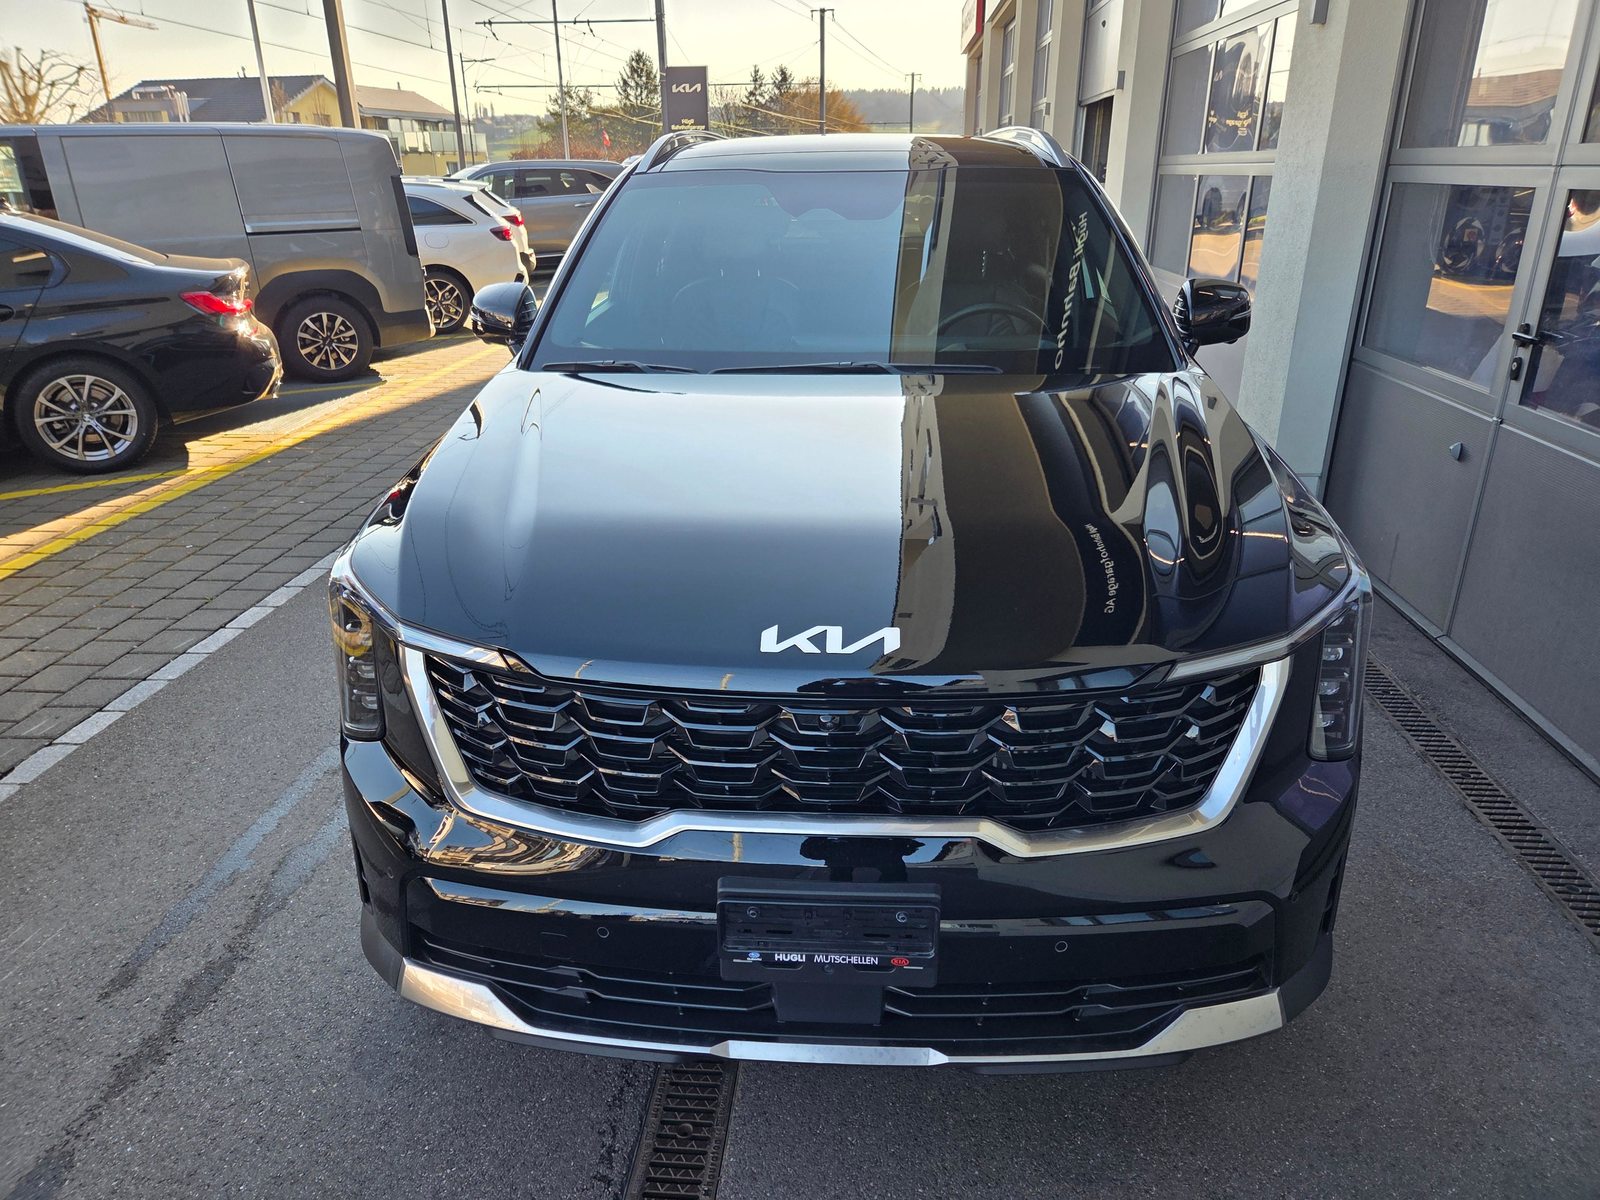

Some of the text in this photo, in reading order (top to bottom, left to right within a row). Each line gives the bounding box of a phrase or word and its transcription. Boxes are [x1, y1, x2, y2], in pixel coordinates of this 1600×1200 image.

[671, 83, 702, 93] KIA
[760, 624, 901, 656] KIA
[813, 954, 879, 965] MUTSCHELLEN
